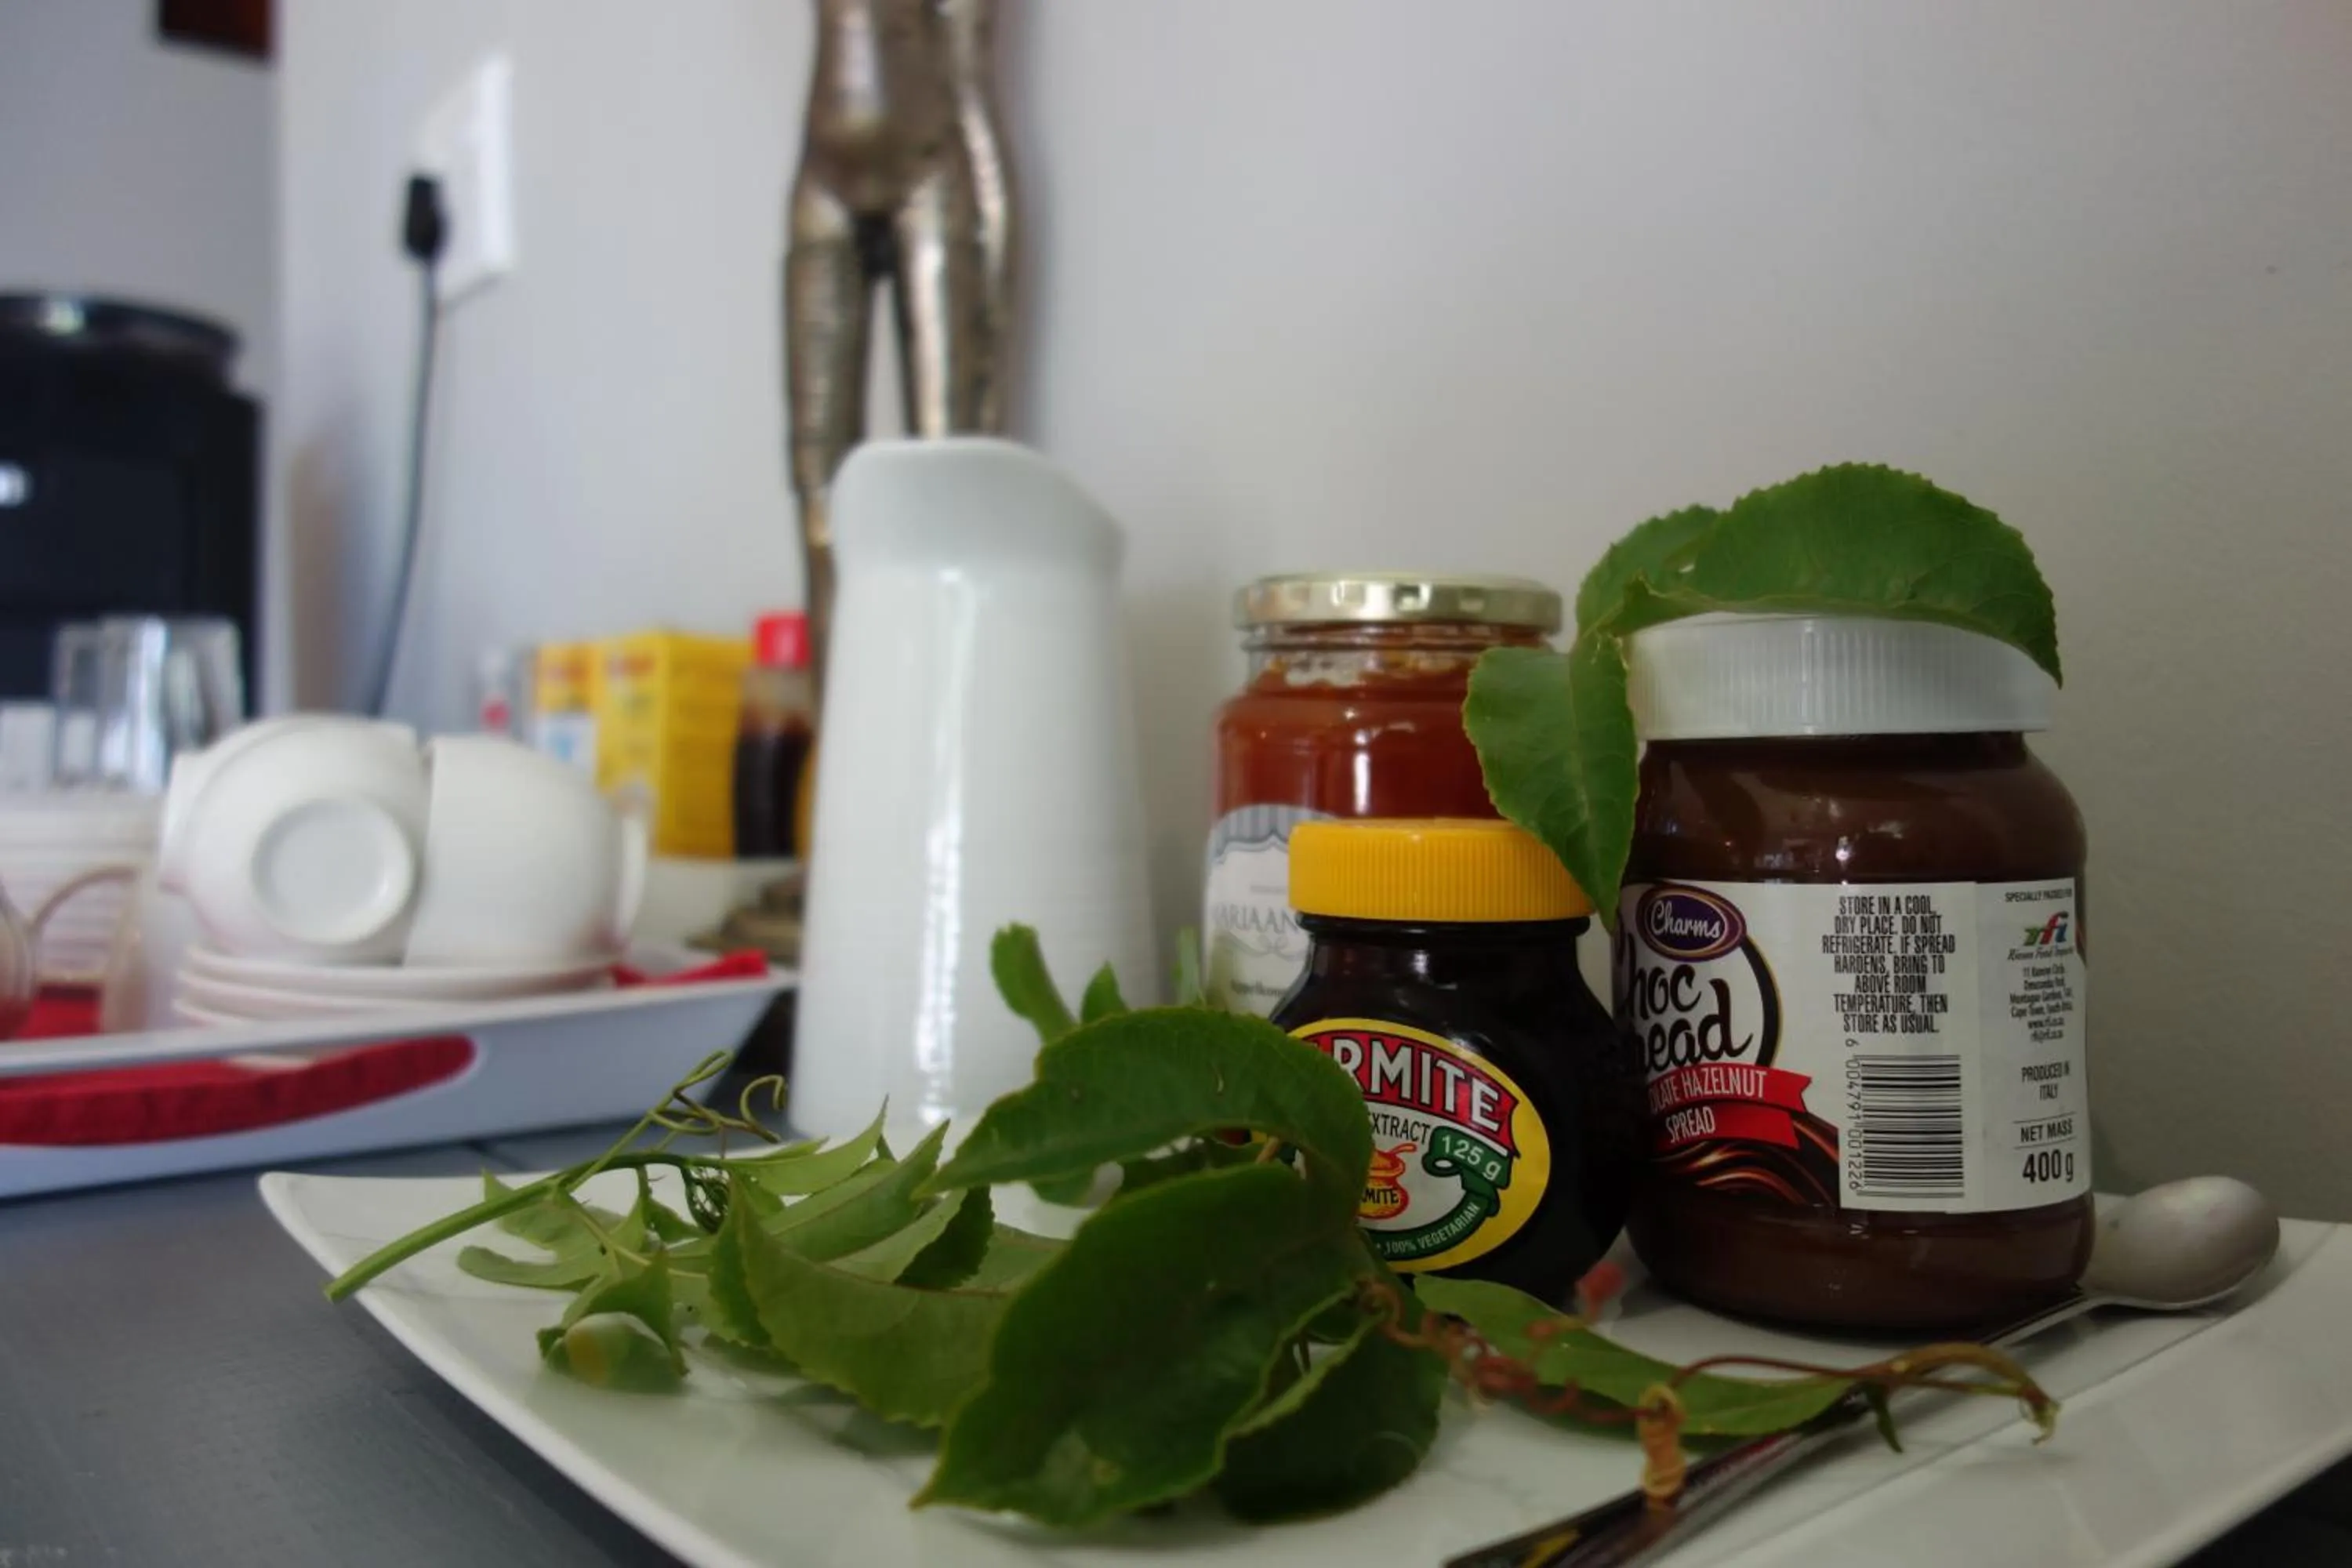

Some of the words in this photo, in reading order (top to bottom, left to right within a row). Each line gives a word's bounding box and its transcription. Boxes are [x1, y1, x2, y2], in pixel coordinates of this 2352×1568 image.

[1839, 895, 1874, 915] STORE
[1878, 895, 1890, 915] IN
[1893, 895, 1902, 915] A
[1650, 899, 1722, 939] Charms
[1835, 916, 1856, 935] DRY
[1860, 915, 1897, 935] PLACE.
[1901, 915, 1917, 935] DO
[1920, 915, 1943, 934] NOT
[1822, 935, 1896, 954] REFRIGERATE.
[1900, 935, 1911, 953] IF
[1914, 934, 1956, 954] SPREAD
[1834, 955, 1889, 975] HARDENS,
[1893, 955, 1928, 974] BRING
[1933, 954, 1945, 974] TO
[1628, 934, 1701, 1021] hoc
[1854, 975, 1890, 993] ABOVE
[1893, 975, 1926, 993] ROOM
[1919, 993, 1948, 1013] THEN
[1843, 1014, 1879, 1033] STORE
[1882, 1014, 1897, 1033] AS
[1900, 1014, 1940, 1033] USUAL.
[2021, 1062, 2063, 1083] PRODUCED
[1333, 1039, 1500, 1132] RMITE
[1648, 1073, 1681, 1112] OLATE
[1680, 1065, 1768, 1100] HAZELNUT
[1845, 1058, 1862, 1120] 004791
[1368, 1112, 1431, 1145] XTRACT
[1664, 1104, 1716, 1144] SPREAD
[2020, 1124, 2044, 1142] NET
[2046, 1118, 2073, 1138] MASS
[1847, 1128, 1865, 1191] 001226
[1363, 1187, 1399, 1205] MITE
[1417, 1202, 1482, 1250] VEGETARIAN
